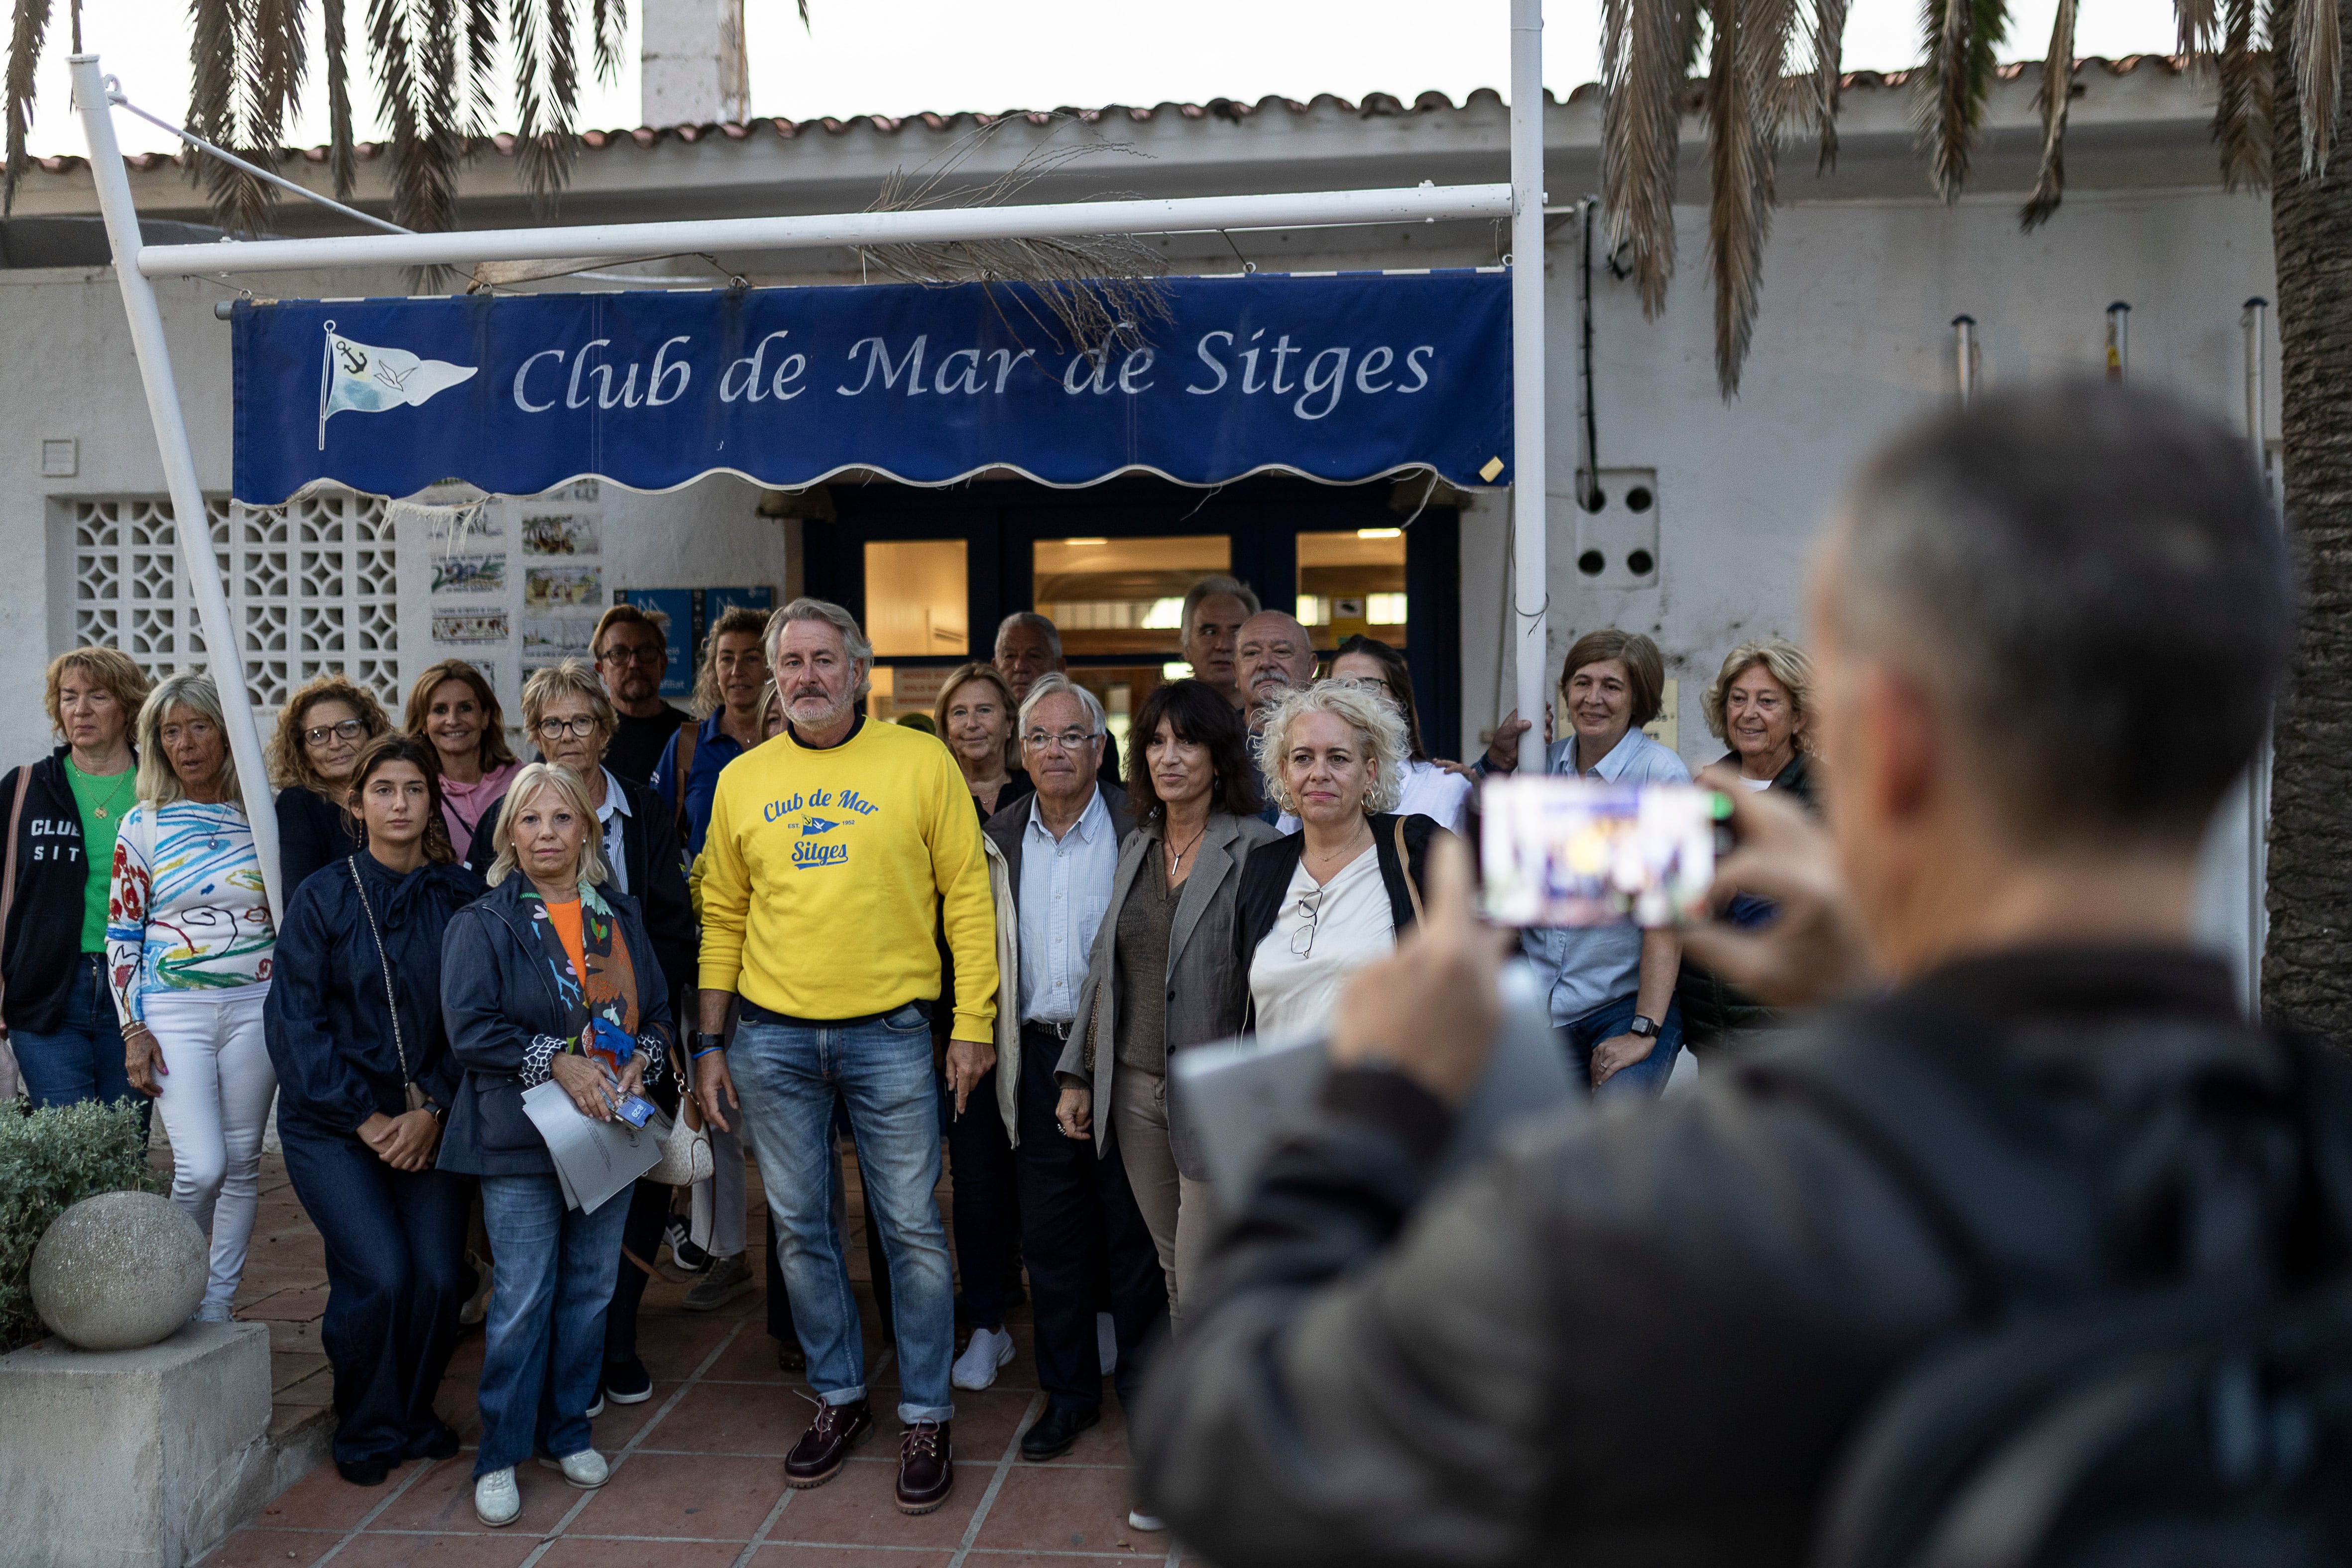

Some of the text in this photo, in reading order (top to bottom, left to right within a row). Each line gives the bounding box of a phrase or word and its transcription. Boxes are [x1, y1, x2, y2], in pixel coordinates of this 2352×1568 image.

[513, 322, 1434, 420] Club de Mar de Sitges
[764, 788, 879, 823] Club de Mar
[791, 841, 848, 866] Sitges
